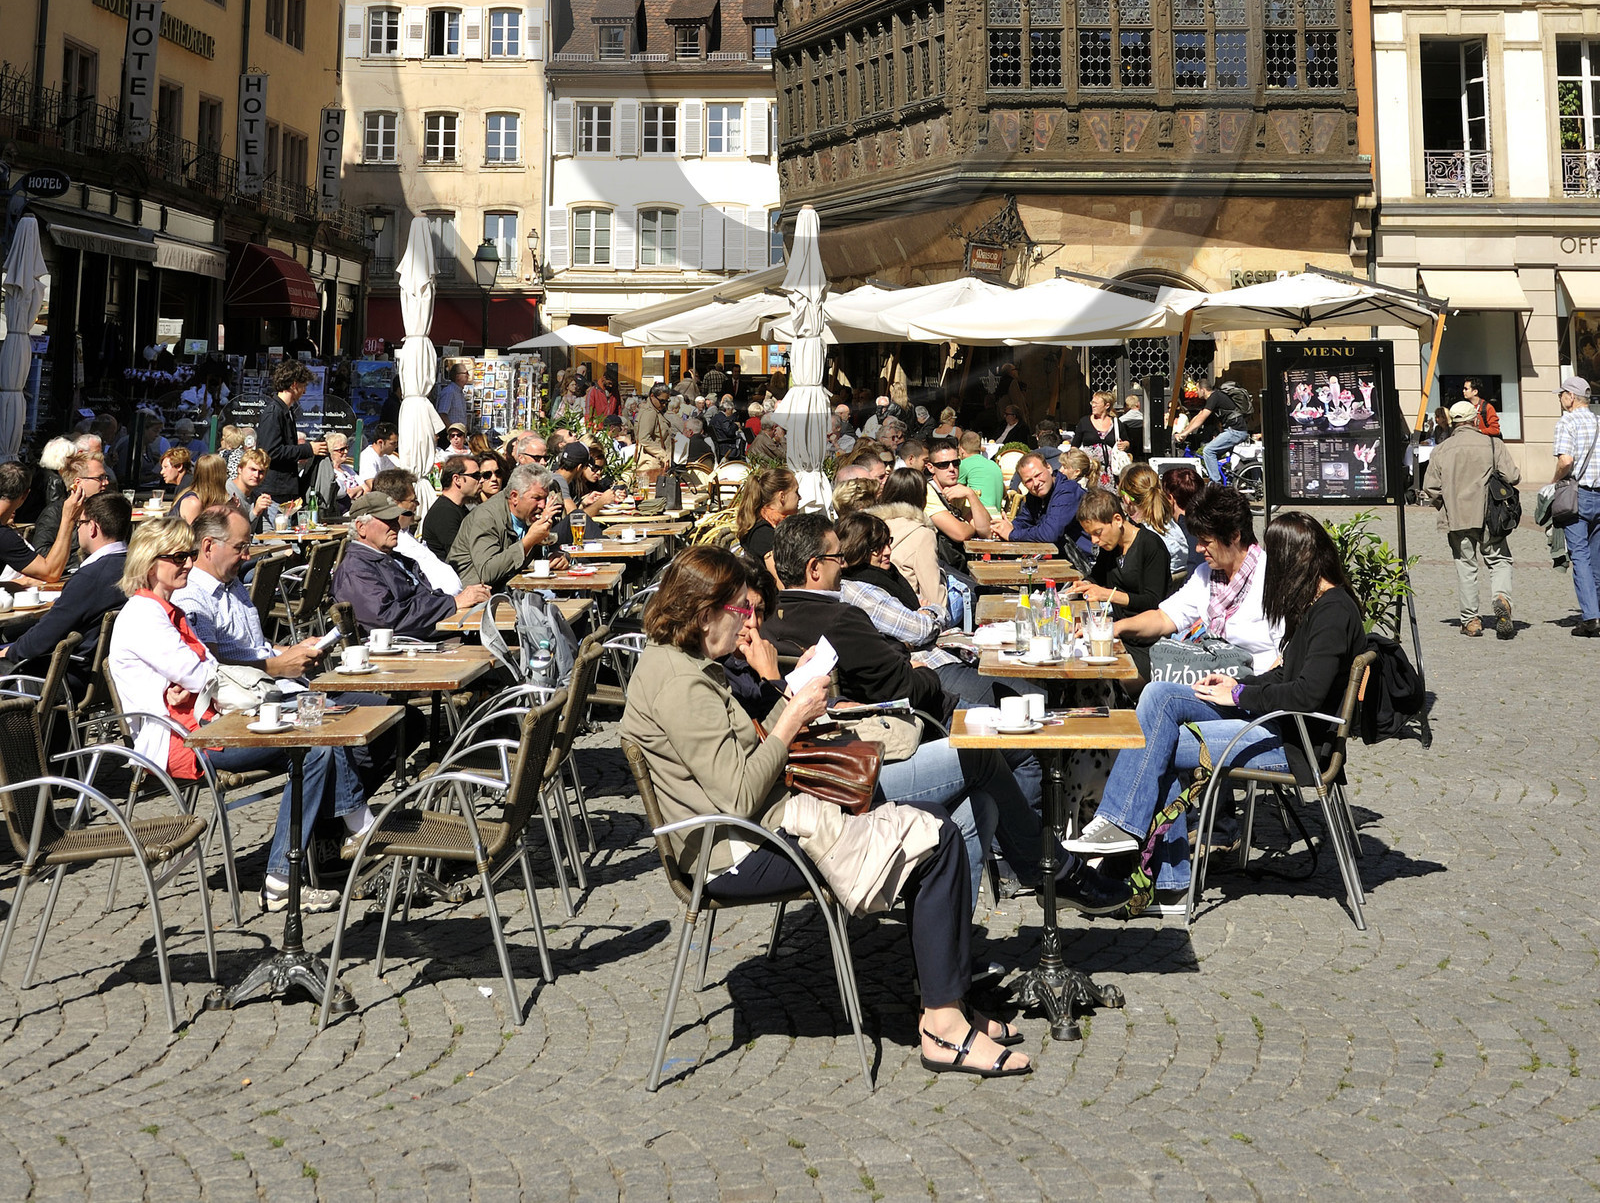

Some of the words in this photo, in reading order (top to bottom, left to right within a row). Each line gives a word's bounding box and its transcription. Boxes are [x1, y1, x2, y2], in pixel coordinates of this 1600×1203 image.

[160, 12, 216, 60] ATHEDRALE
[129, 3, 155, 121] HOTEL
[243, 77, 262, 176] HOTEL
[322, 111, 341, 197] HOTEL
[28, 176, 62, 190] HOTEL
[1560, 236, 1599, 254] OFF
[1303, 347, 1356, 357] MENU
